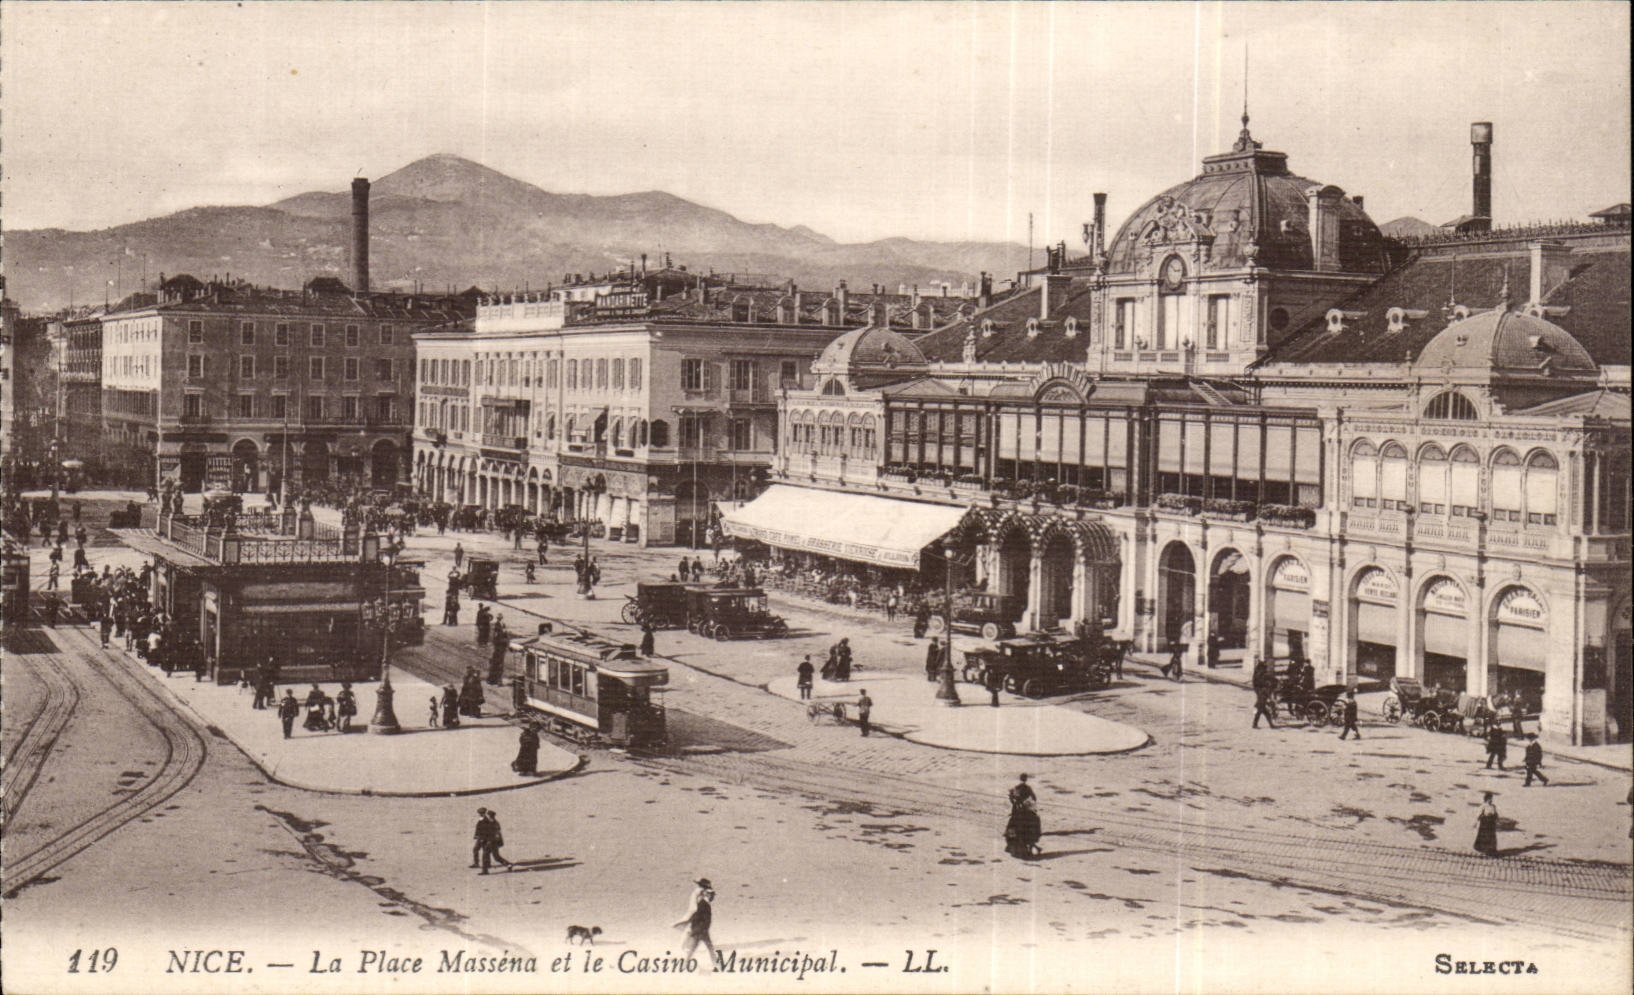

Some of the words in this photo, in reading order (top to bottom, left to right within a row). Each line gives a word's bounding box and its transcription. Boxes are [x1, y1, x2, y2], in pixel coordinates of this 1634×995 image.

[207, 457, 233, 466] VITTEL
[1283, 574, 1308, 584] PARISIEN
[1502, 589, 1524, 609] GRAND
[1510, 606, 1541, 619] PARISIEN
